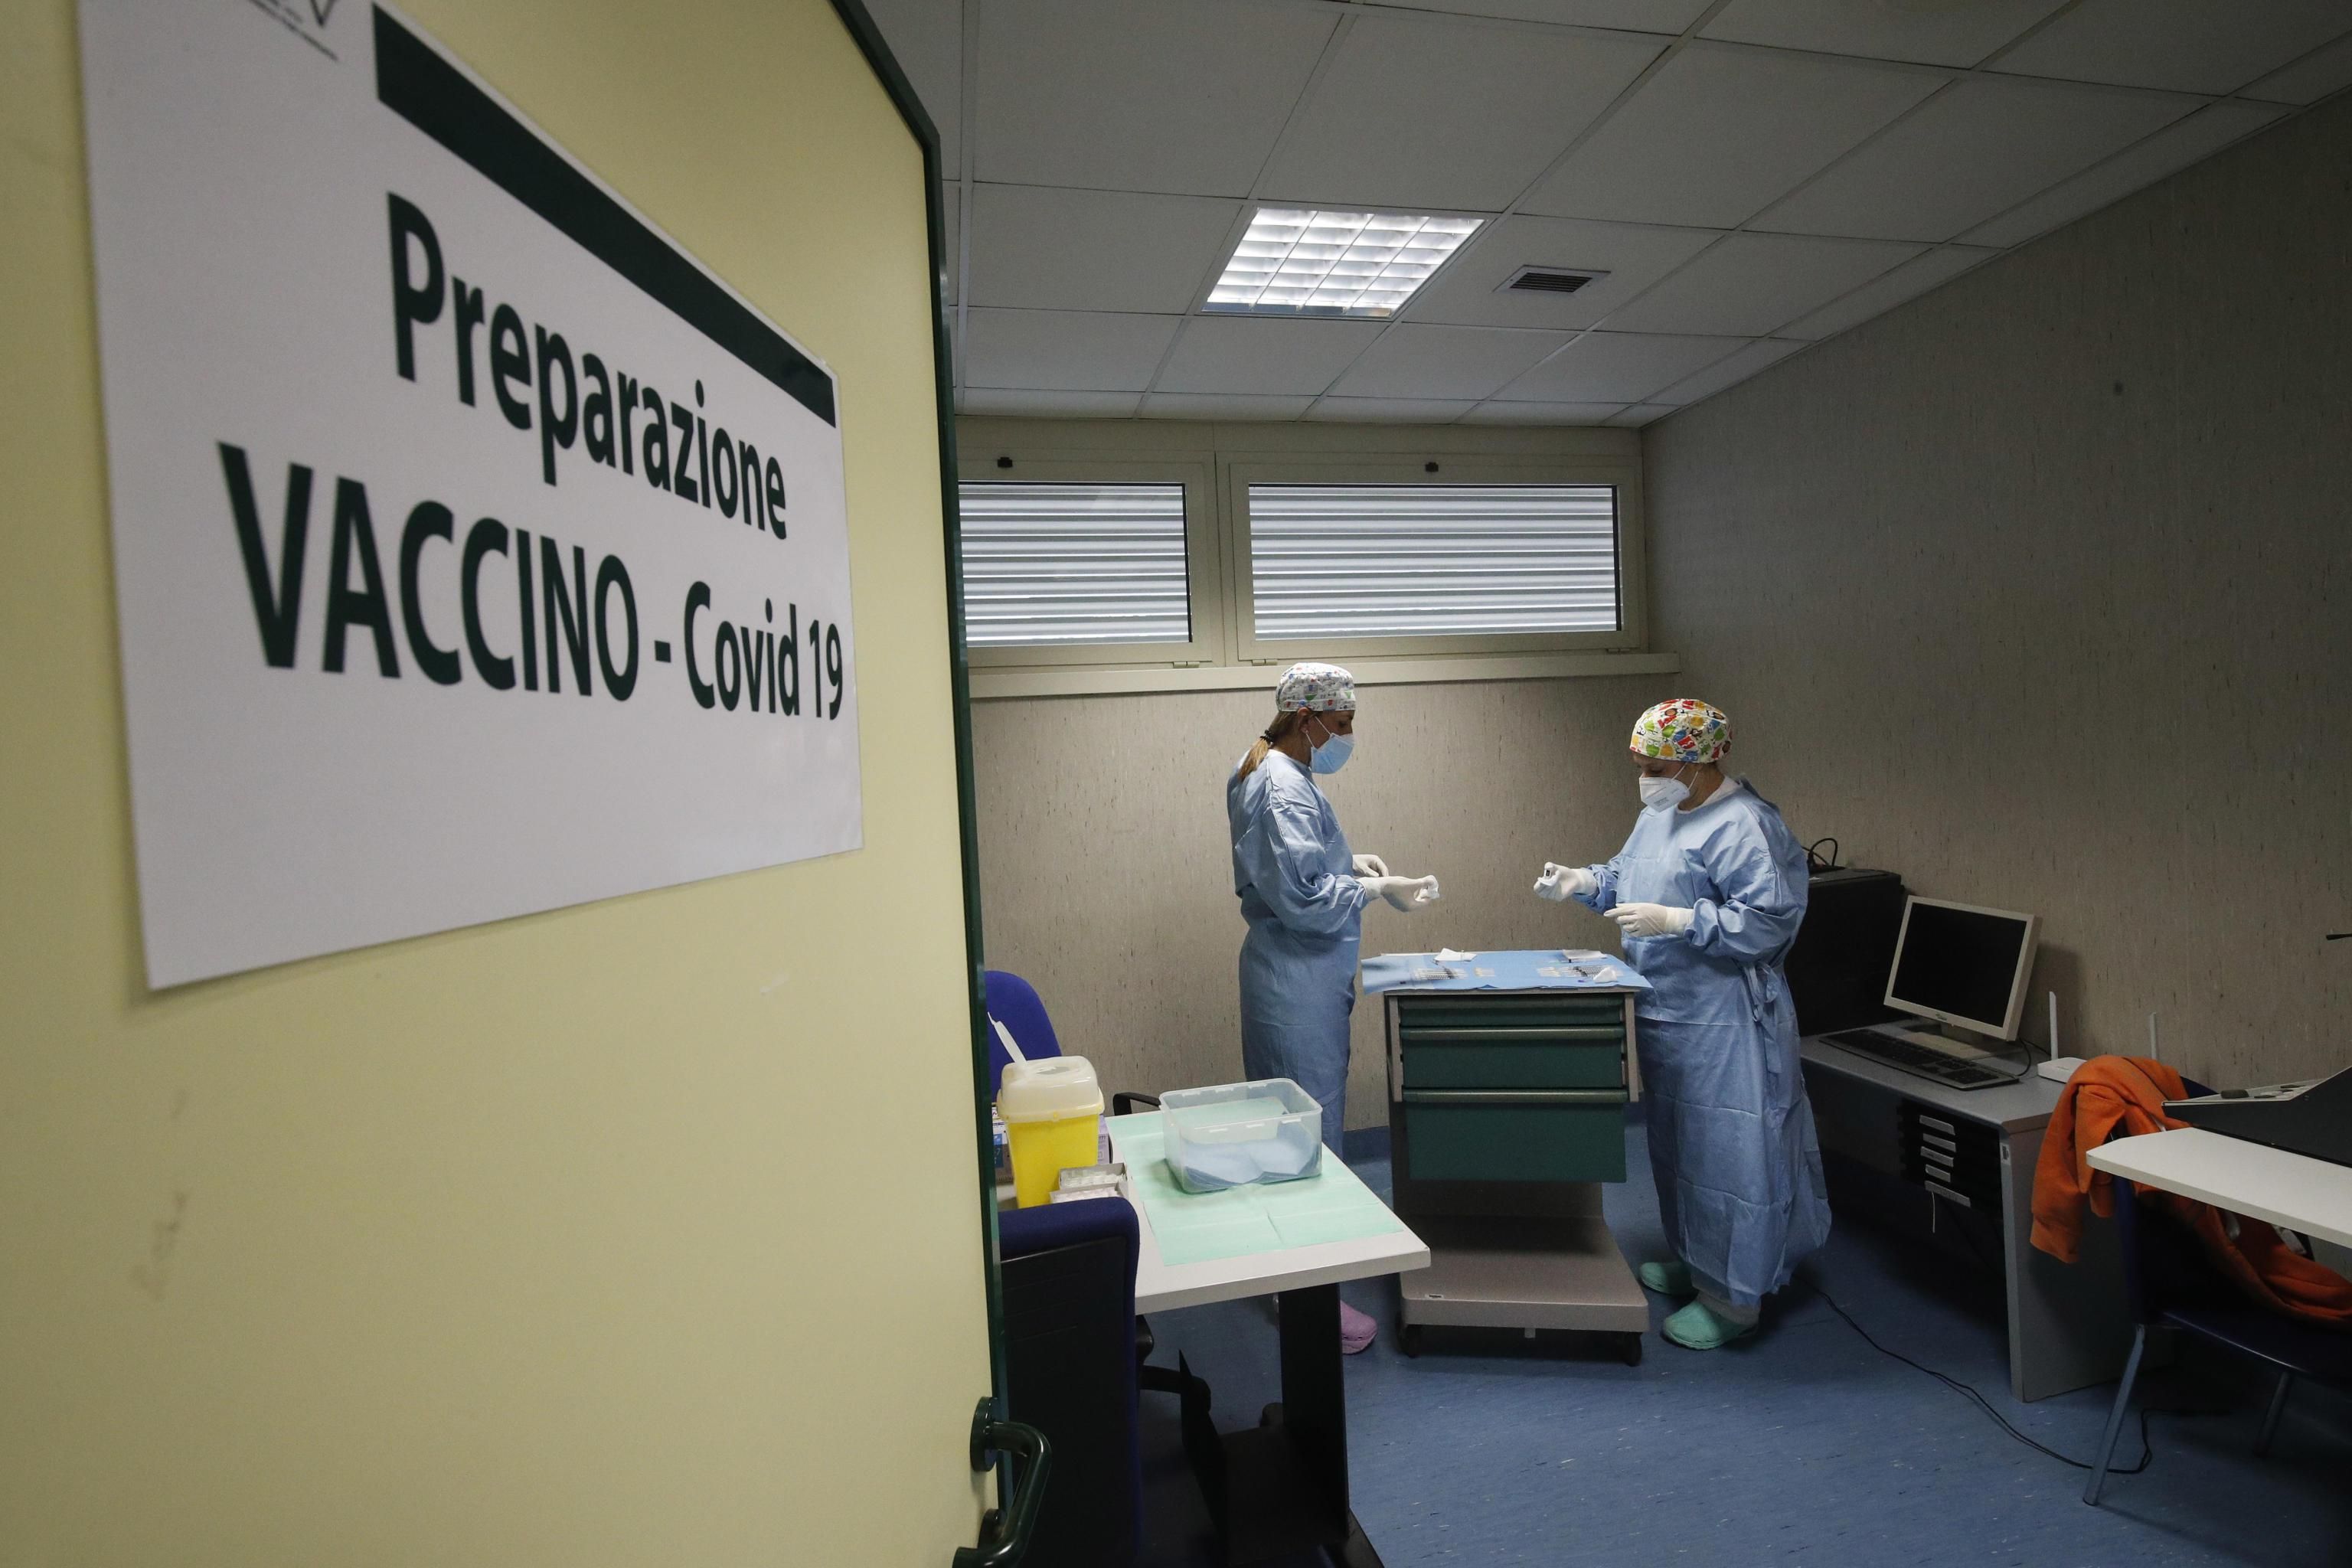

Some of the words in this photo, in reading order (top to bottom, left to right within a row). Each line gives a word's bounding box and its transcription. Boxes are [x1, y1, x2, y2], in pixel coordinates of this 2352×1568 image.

[387, 191, 787, 540] Preparazione
[217, 441, 640, 701] VACCINO
[684, 581, 800, 718] Covid
[808, 619, 843, 720] 19
